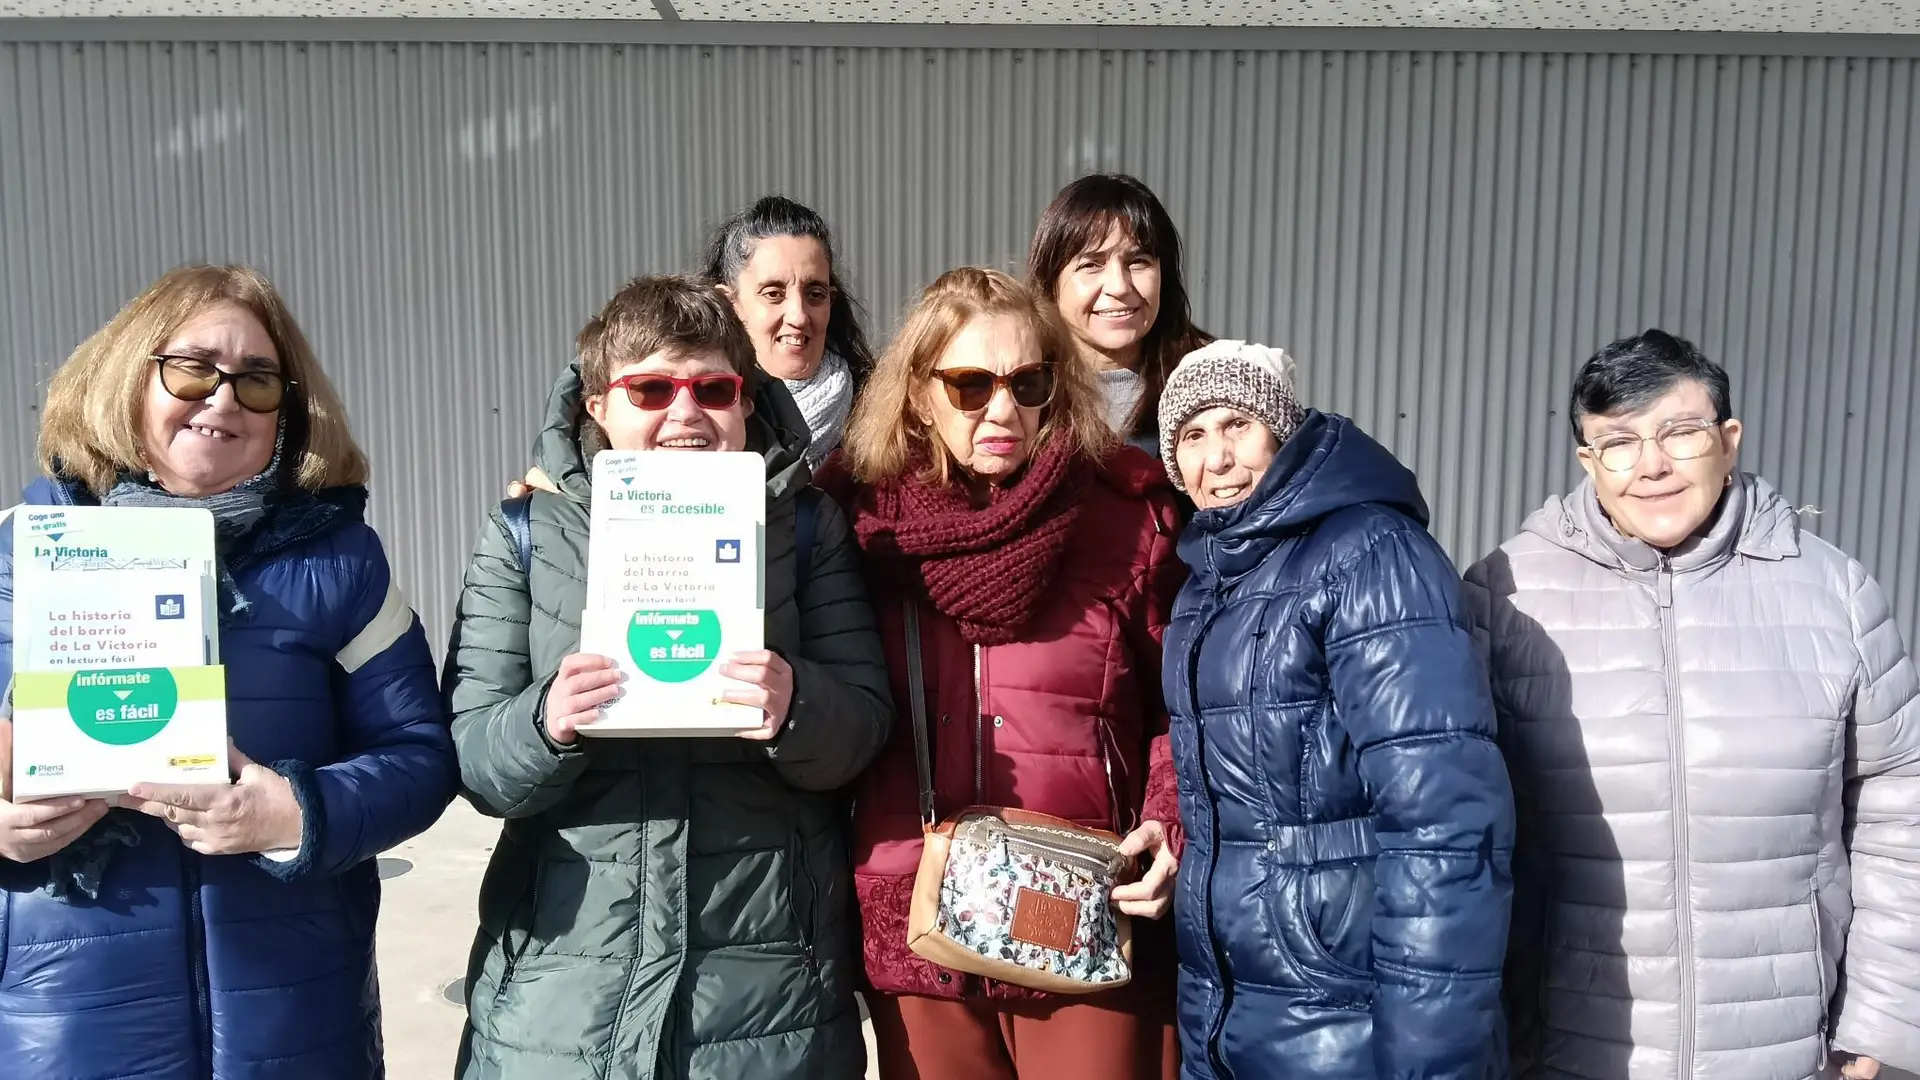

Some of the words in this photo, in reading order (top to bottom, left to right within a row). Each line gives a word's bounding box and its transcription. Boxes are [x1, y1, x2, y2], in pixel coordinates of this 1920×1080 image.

[610, 490, 623, 500] La
[627, 490, 672, 501] Victoria
[640, 504, 655, 514] es
[661, 503, 725, 514] accesible
[28, 513, 48, 521] Coge
[43, 522, 67, 530] gratis
[34, 546, 50, 557] La
[55, 547, 108, 558] Victoria
[624, 553, 639, 562] La
[644, 553, 694, 562] historia
[624, 568, 644, 577] del
[648, 568, 689, 577] barrio
[623, 582, 639, 591] de
[644, 582, 658, 591] La
[664, 582, 715, 592] Victoria
[49, 611, 66, 621] La
[72, 610, 131, 620] historia
[49, 626, 73, 636] del
[78, 625, 126, 636] barrio
[50, 641, 68, 651] de
[74, 641, 91, 651] La
[97, 640, 157, 650] Victoria
[650, 647, 667, 658] es
[671, 643, 705, 658] fácil
[67, 656, 107, 664] lectura
[111, 655, 135, 663] fácil
[95, 708, 115, 721] es
[120, 704, 158, 720] fácil
